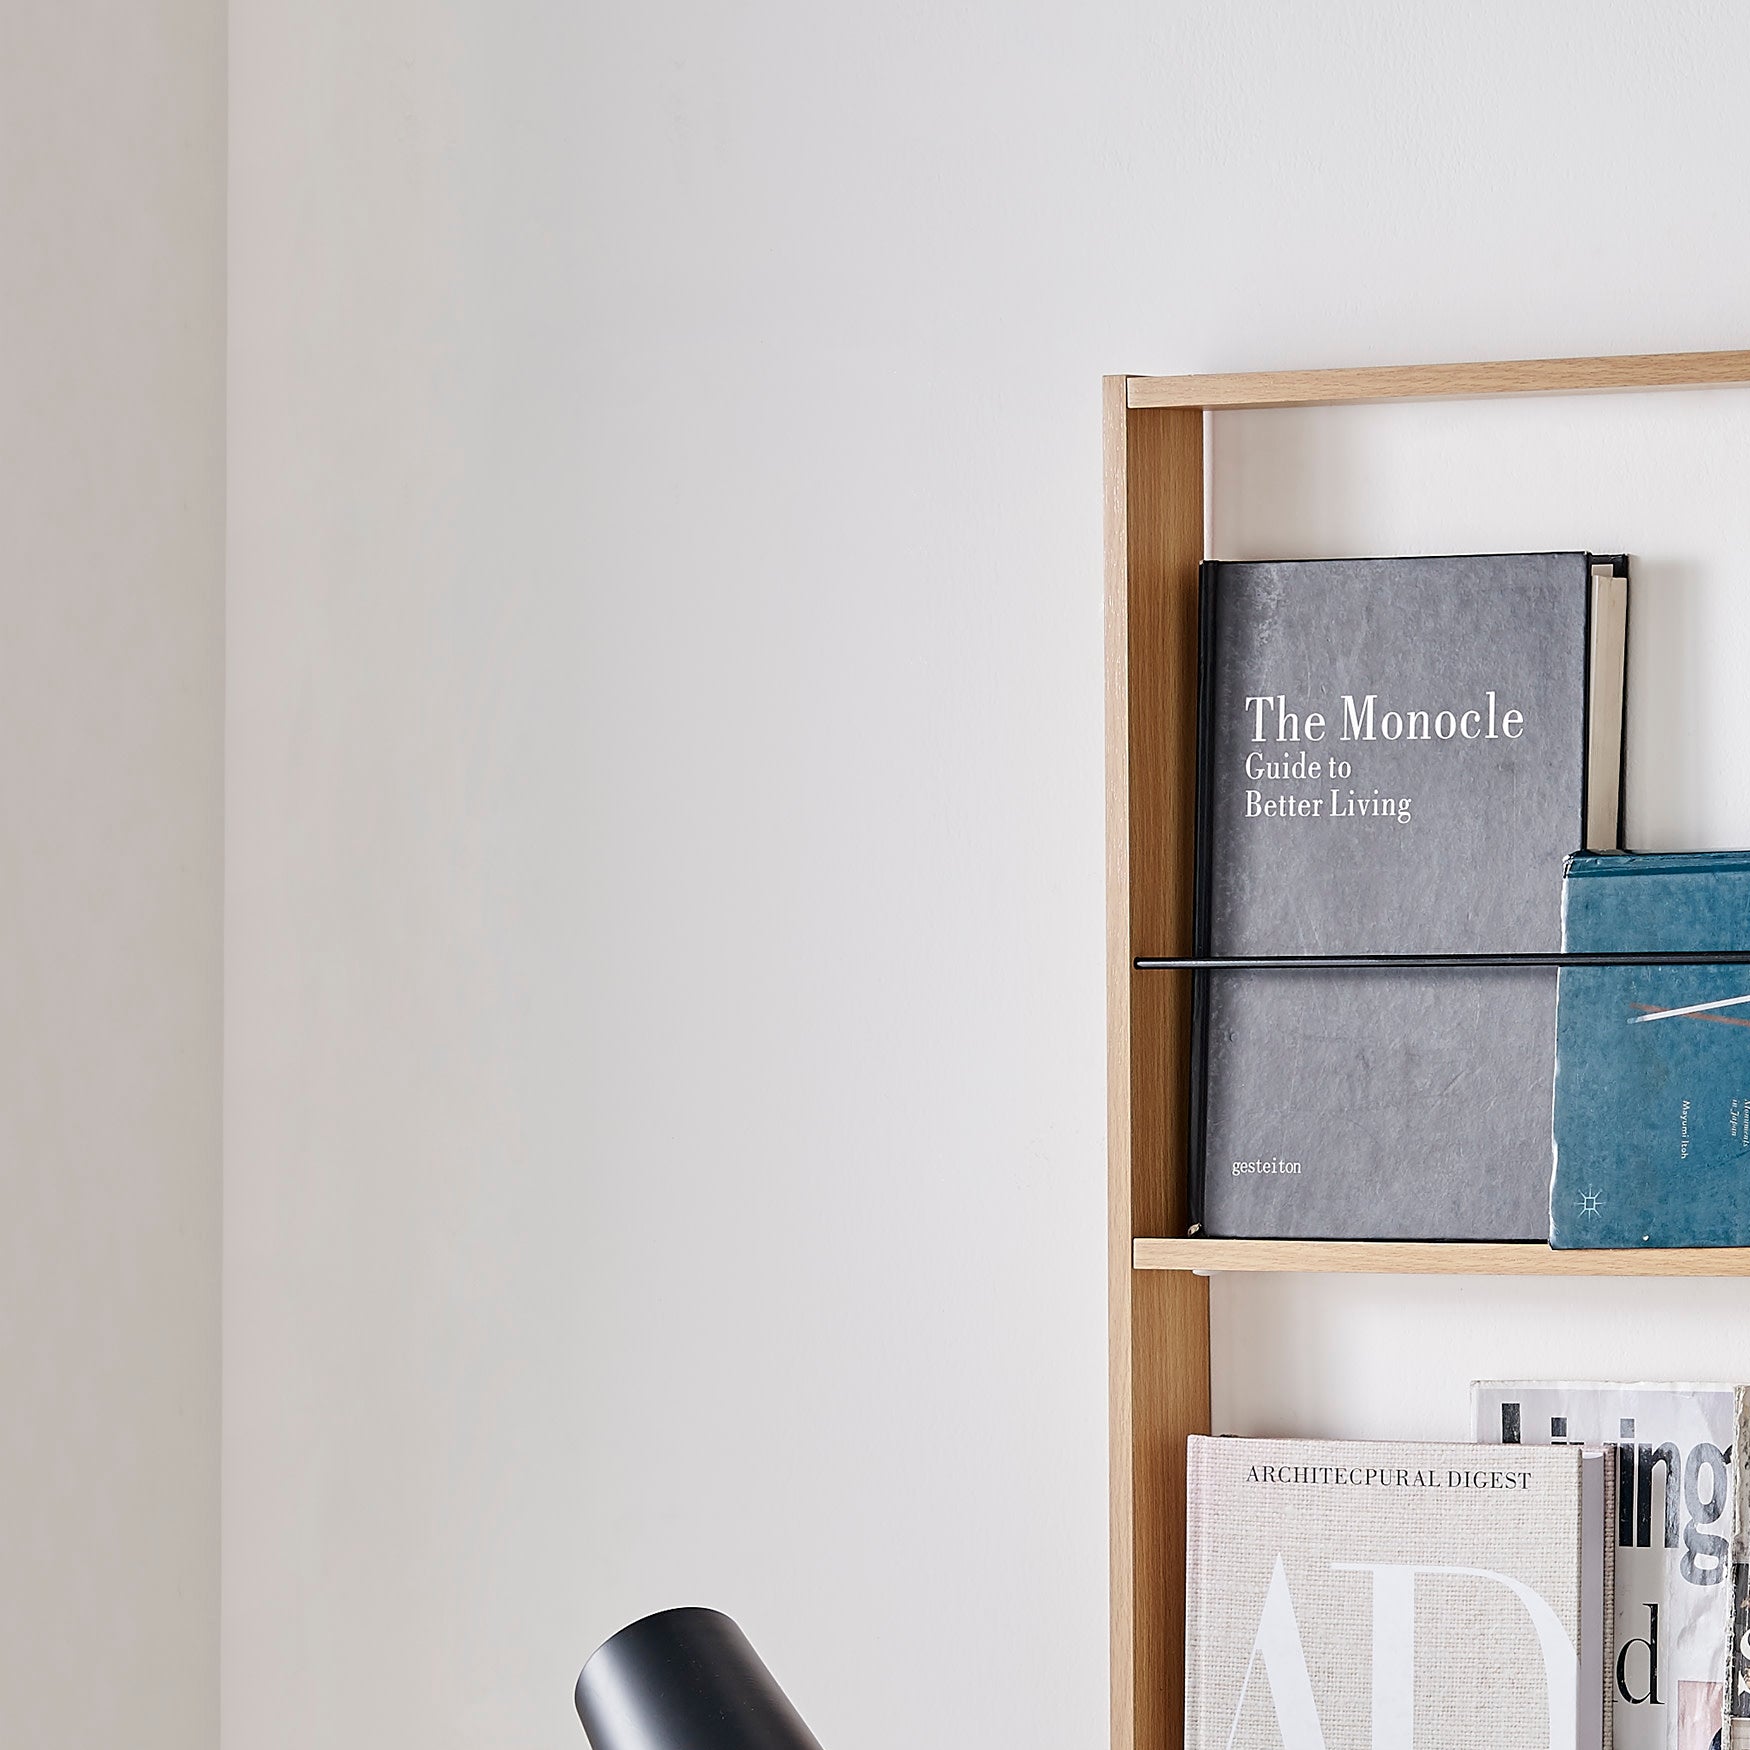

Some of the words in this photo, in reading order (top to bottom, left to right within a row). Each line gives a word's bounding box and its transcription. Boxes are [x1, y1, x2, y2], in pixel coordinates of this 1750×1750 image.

[1245, 694, 1326, 743] The
[1340, 691, 1525, 742] Monocle
[1245, 750, 1322, 780] Guide
[1329, 755, 1352, 780] to
[1245, 789, 1324, 818] Better
[1330, 788, 1412, 824] Living
[1731, 1098, 1739, 1108] in
[1680, 1100, 1691, 1138] Mayumi
[1729, 1108, 1740, 1137] Japan
[1680, 1140, 1690, 1160] Itoh
[1232, 1157, 1302, 1177] gesteiton
[1245, 1465, 1441, 1489] ARCHITECPURAL
[1447, 1470, 1532, 1490] DIGEST
